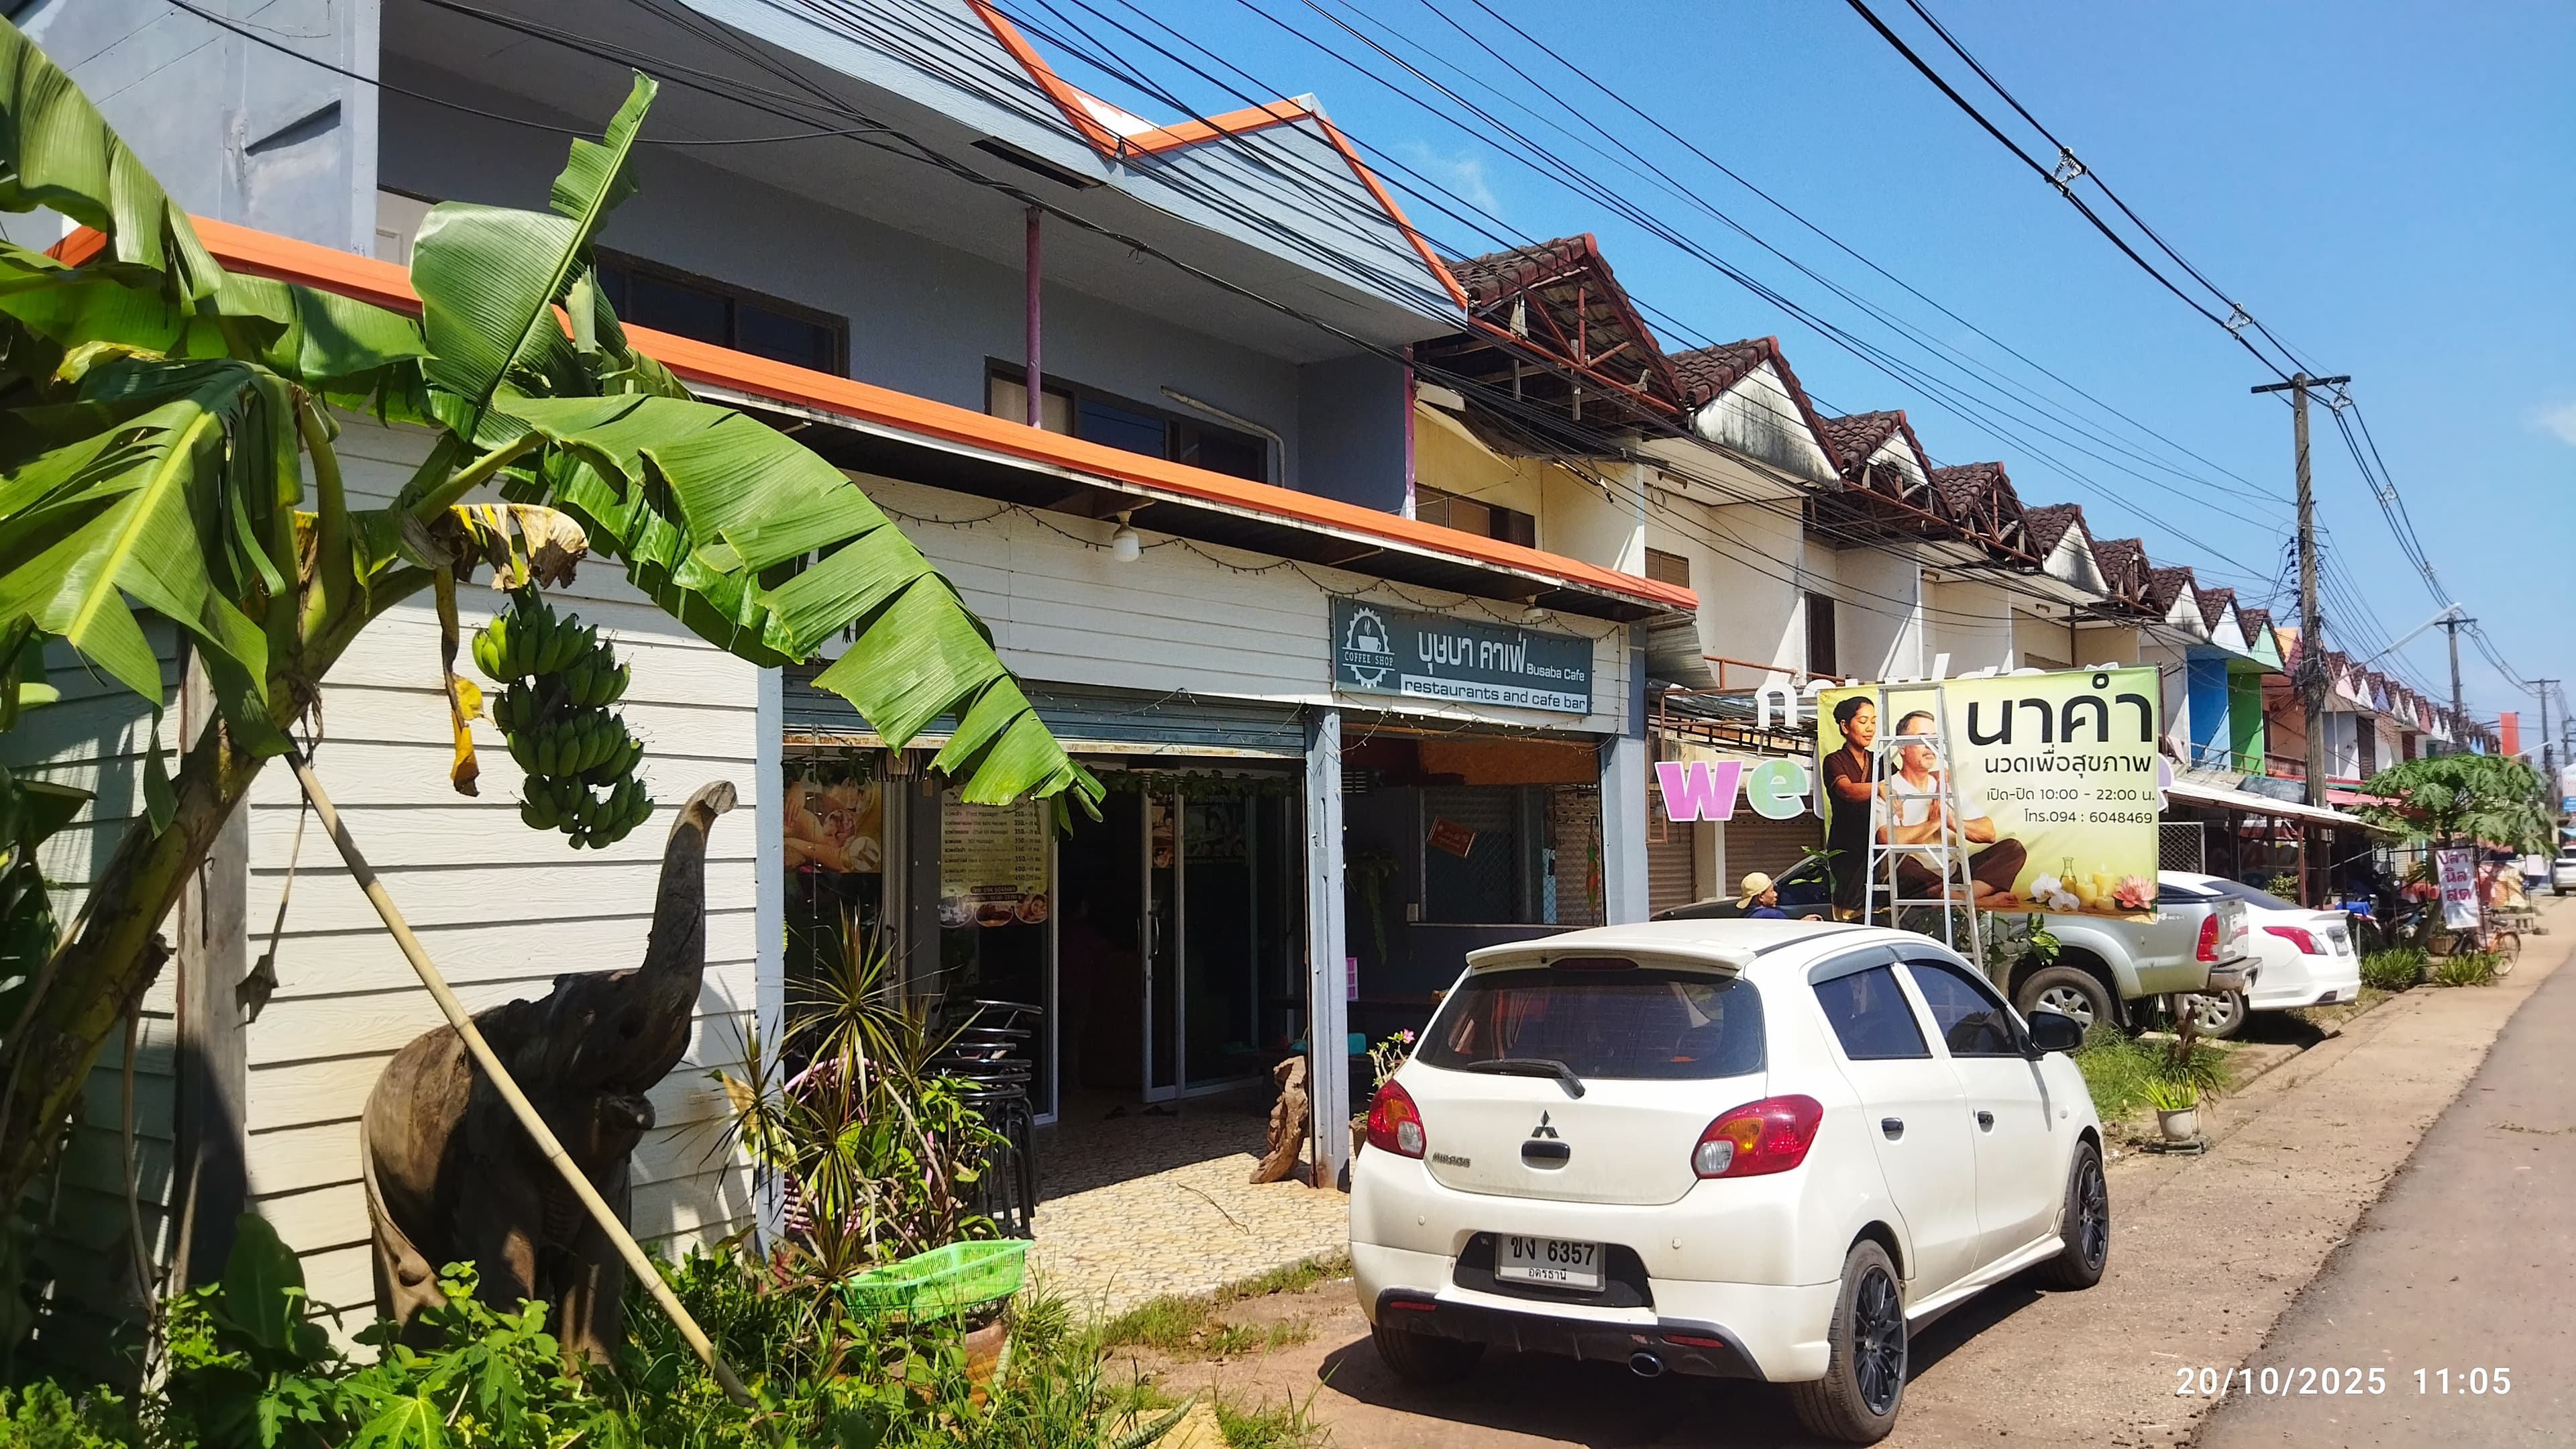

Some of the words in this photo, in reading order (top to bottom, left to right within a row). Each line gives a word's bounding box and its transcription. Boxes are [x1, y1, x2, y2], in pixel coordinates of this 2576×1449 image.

[1344, 651, 1371, 665] COFFEE
[1375, 653, 1394, 667] SHOP
[1417, 631, 1473, 675] บุษบา
[1480, 627, 1527, 673] คาเฟ่
[1526, 663, 1562, 679] Busaba
[1564, 668, 1585, 682] Cafe
[1405, 678, 1499, 701] restaurants
[1503, 690, 1529, 704] and
[1532, 693, 1560, 707] cafe
[1564, 694, 1585, 710] bar
[1968, 673, 2153, 746] นาคำ
[1985, 744, 2151, 779] นวดเพื่อสุขภาพ
[1987, 788, 2034, 800] เปิด-ปิด
[2040, 789, 2078, 800] 10:00
[2096, 790, 2137, 800] 22:00
[2142, 790, 2155, 801] น.
[2025, 808, 2076, 822] โทร.094
[2090, 812, 2152, 823] 6048469
[1511, 1237, 1536, 1259] ขง
[1547, 1241, 1595, 1265] 6357
[1528, 1268, 1566, 1281] อดรธานี
